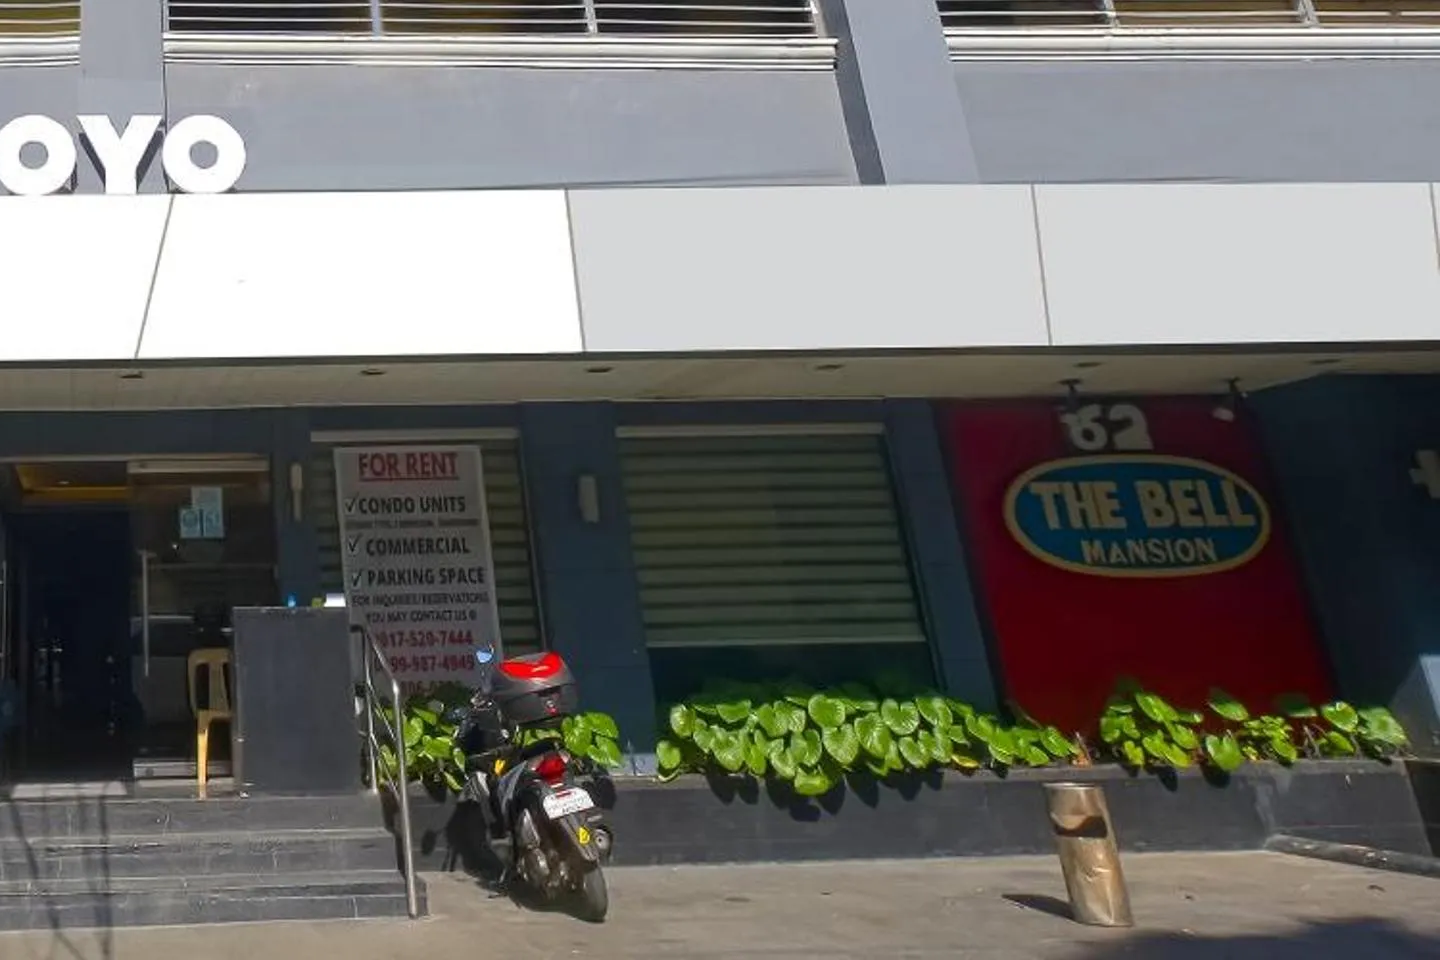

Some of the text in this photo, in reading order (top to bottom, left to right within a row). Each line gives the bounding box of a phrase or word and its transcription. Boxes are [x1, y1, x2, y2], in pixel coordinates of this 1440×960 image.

[1067, 403, 1154, 451] 62
[358, 452, 458, 478] FOR RENT
[358, 496, 466, 515] CONDO UNITS
[1030, 478, 1257, 530] THE BELL
[366, 537, 471, 556] COMMERCIAL
[1080, 536, 1218, 566] MANSION
[367, 567, 486, 587] PARKING SPACE
[387, 611, 408, 623] MAY
[409, 610, 453, 622] CONTACT
